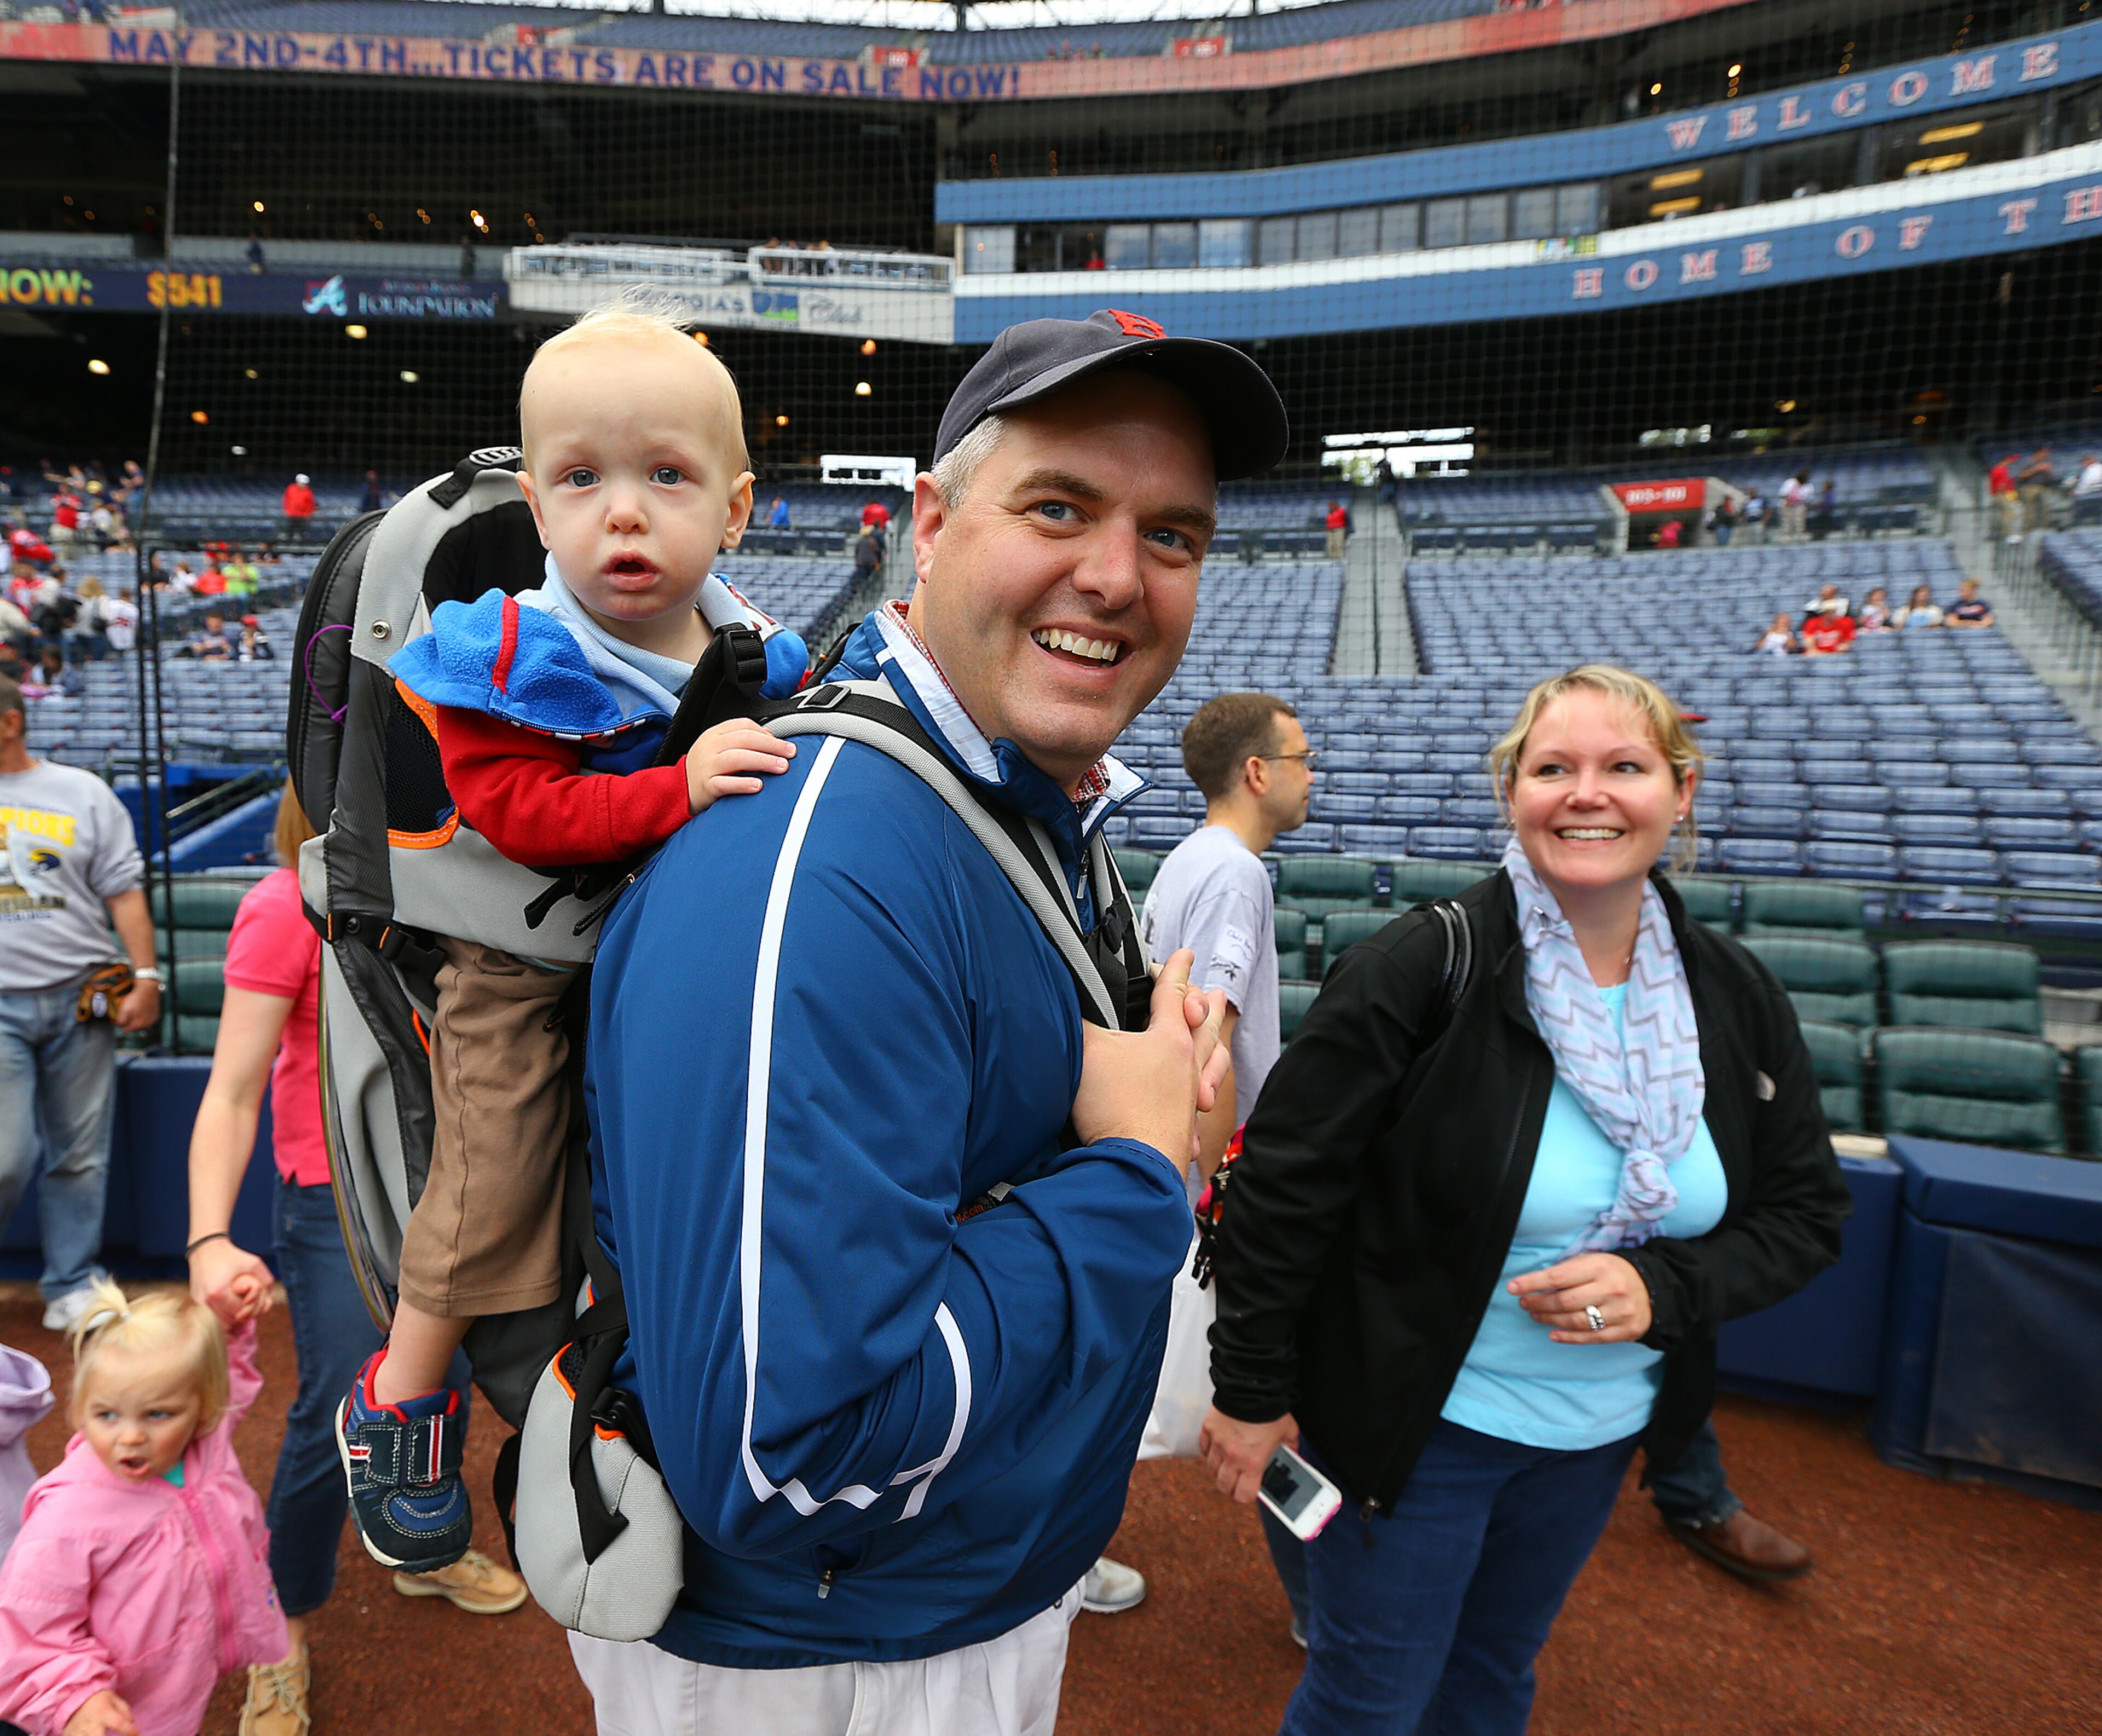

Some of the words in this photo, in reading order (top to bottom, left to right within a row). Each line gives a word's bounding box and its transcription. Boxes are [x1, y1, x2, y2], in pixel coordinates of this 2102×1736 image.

[109, 30, 195, 64] MAY
[636, 55, 714, 86] ARE
[732, 60, 785, 90] ON
[802, 62, 904, 96] SALE
[920, 66, 1020, 99] NOW!
[1664, 42, 2060, 151] WELCOME
[1572, 241, 1773, 299] HOME
[1834, 214, 1934, 259] OF
[1999, 184, 2102, 236] TH
[146, 268, 222, 308] $541
